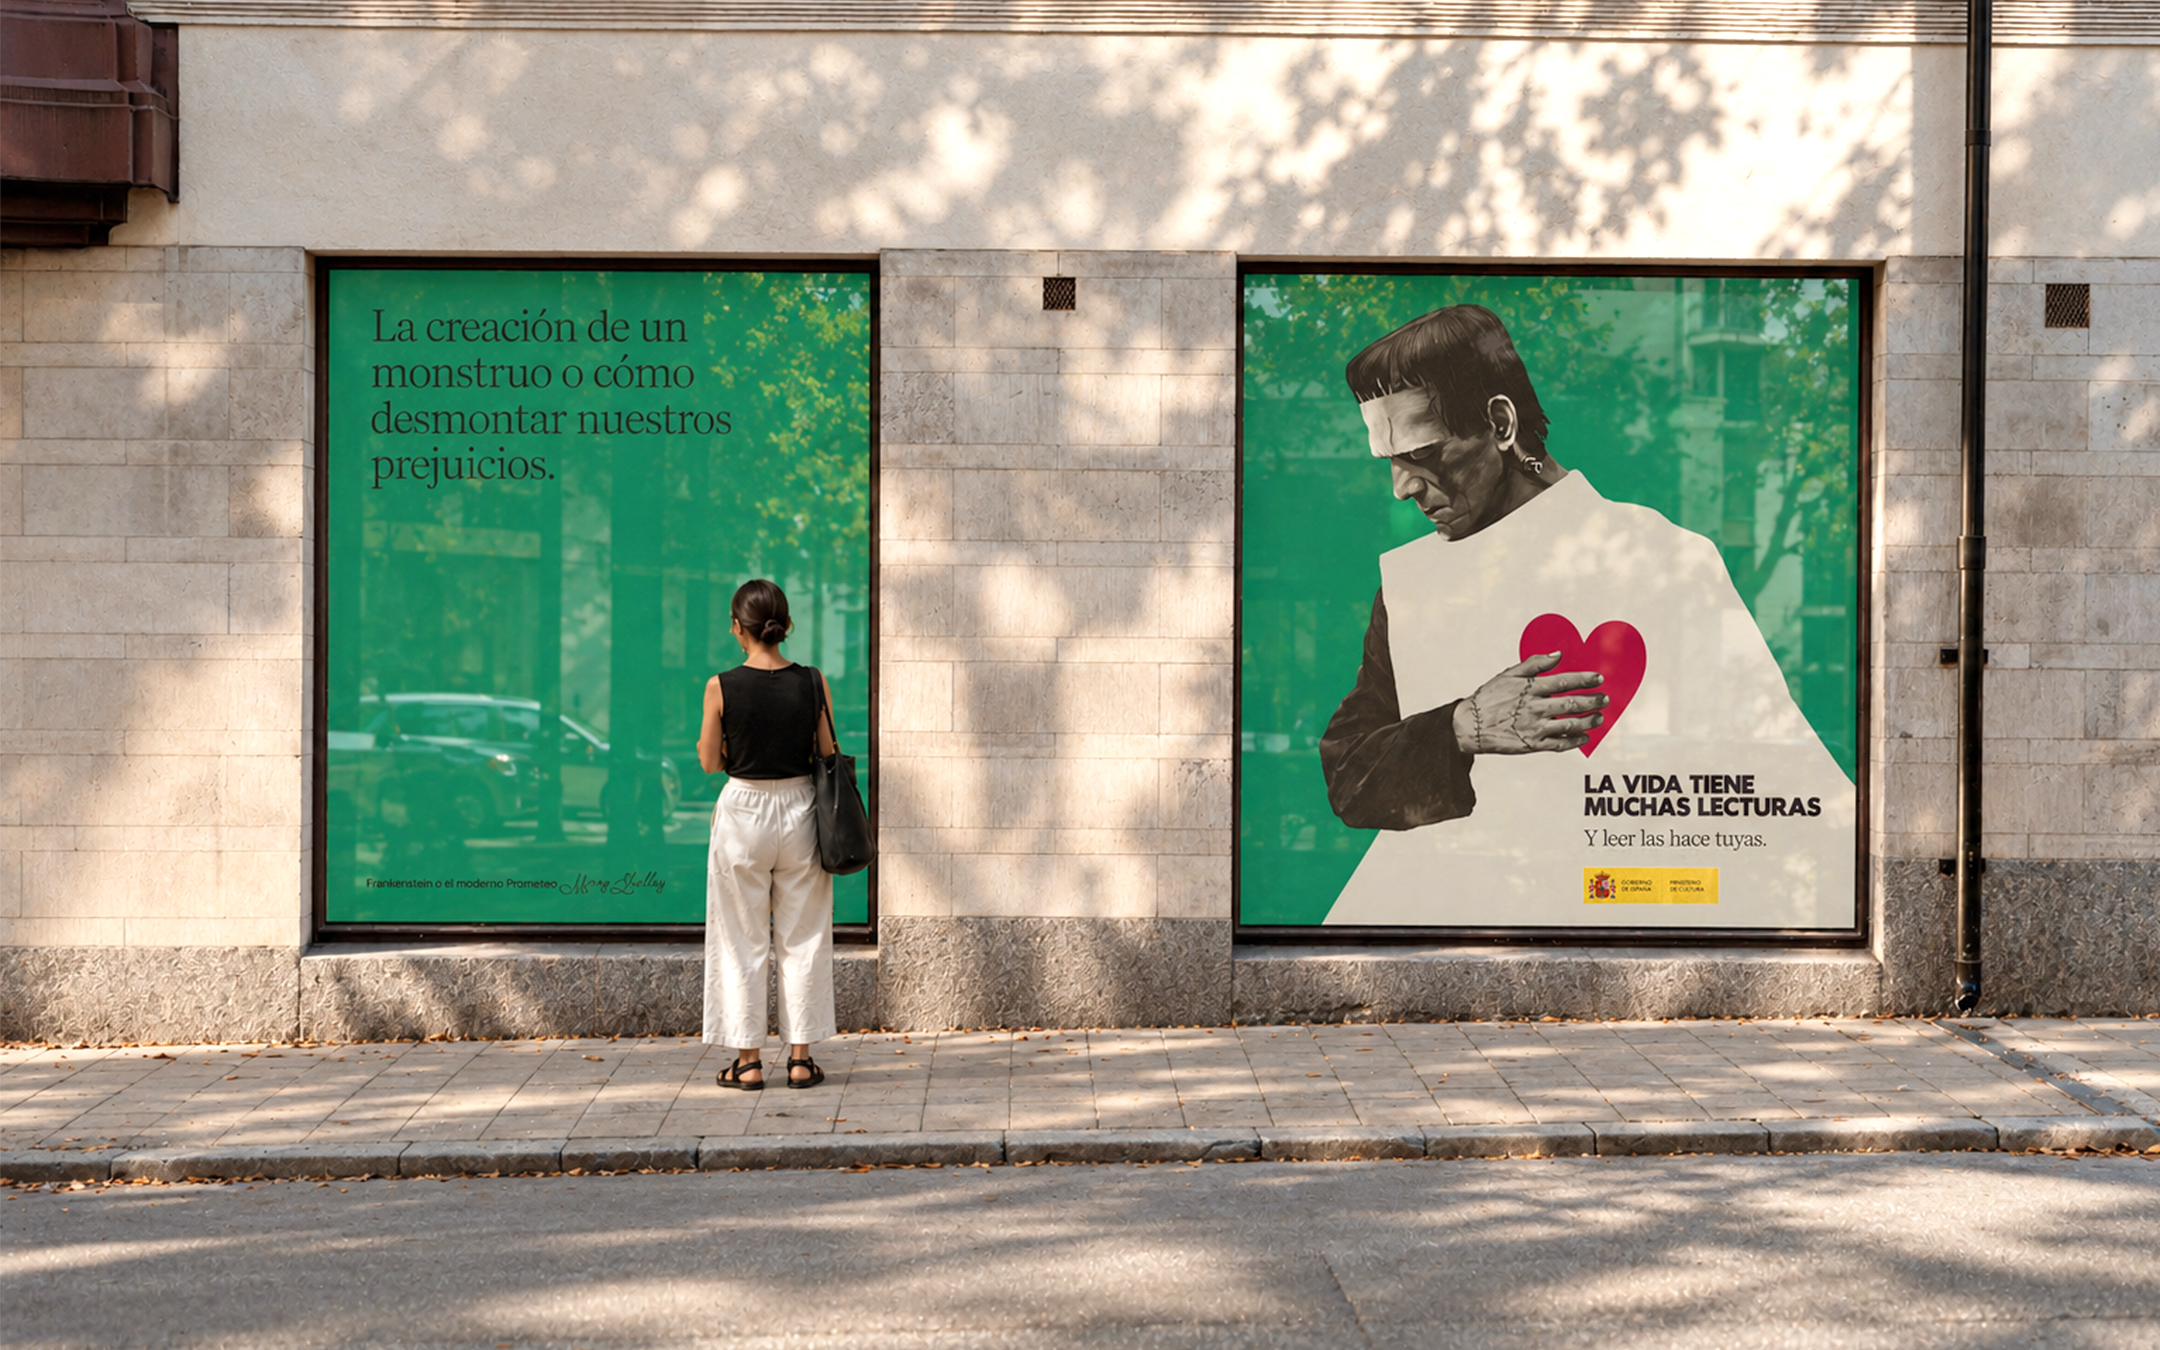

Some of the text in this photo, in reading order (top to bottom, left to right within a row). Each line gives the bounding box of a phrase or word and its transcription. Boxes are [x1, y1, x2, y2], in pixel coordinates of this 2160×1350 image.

[373, 309, 688, 343] La creación de un
[371, 354, 695, 389] monstruo o cómo
[371, 401, 732, 435] desmontar nuestros
[371, 446, 555, 490] prejuicios.
[1584, 774, 1755, 794] LA VIDA TIENE
[1584, 797, 1822, 817] MUCHAS LECTURAS
[1583, 829, 1767, 851] Y leer las hace tuyas.
[366, 878, 433, 889] Frankenstein
[434, 880, 443, 889] o
[444, 878, 454, 889] el
[456, 878, 504, 889] moderno
[506, 878, 558, 889] Prometeo
[1630, 885, 1652, 893] ESPAÑA
